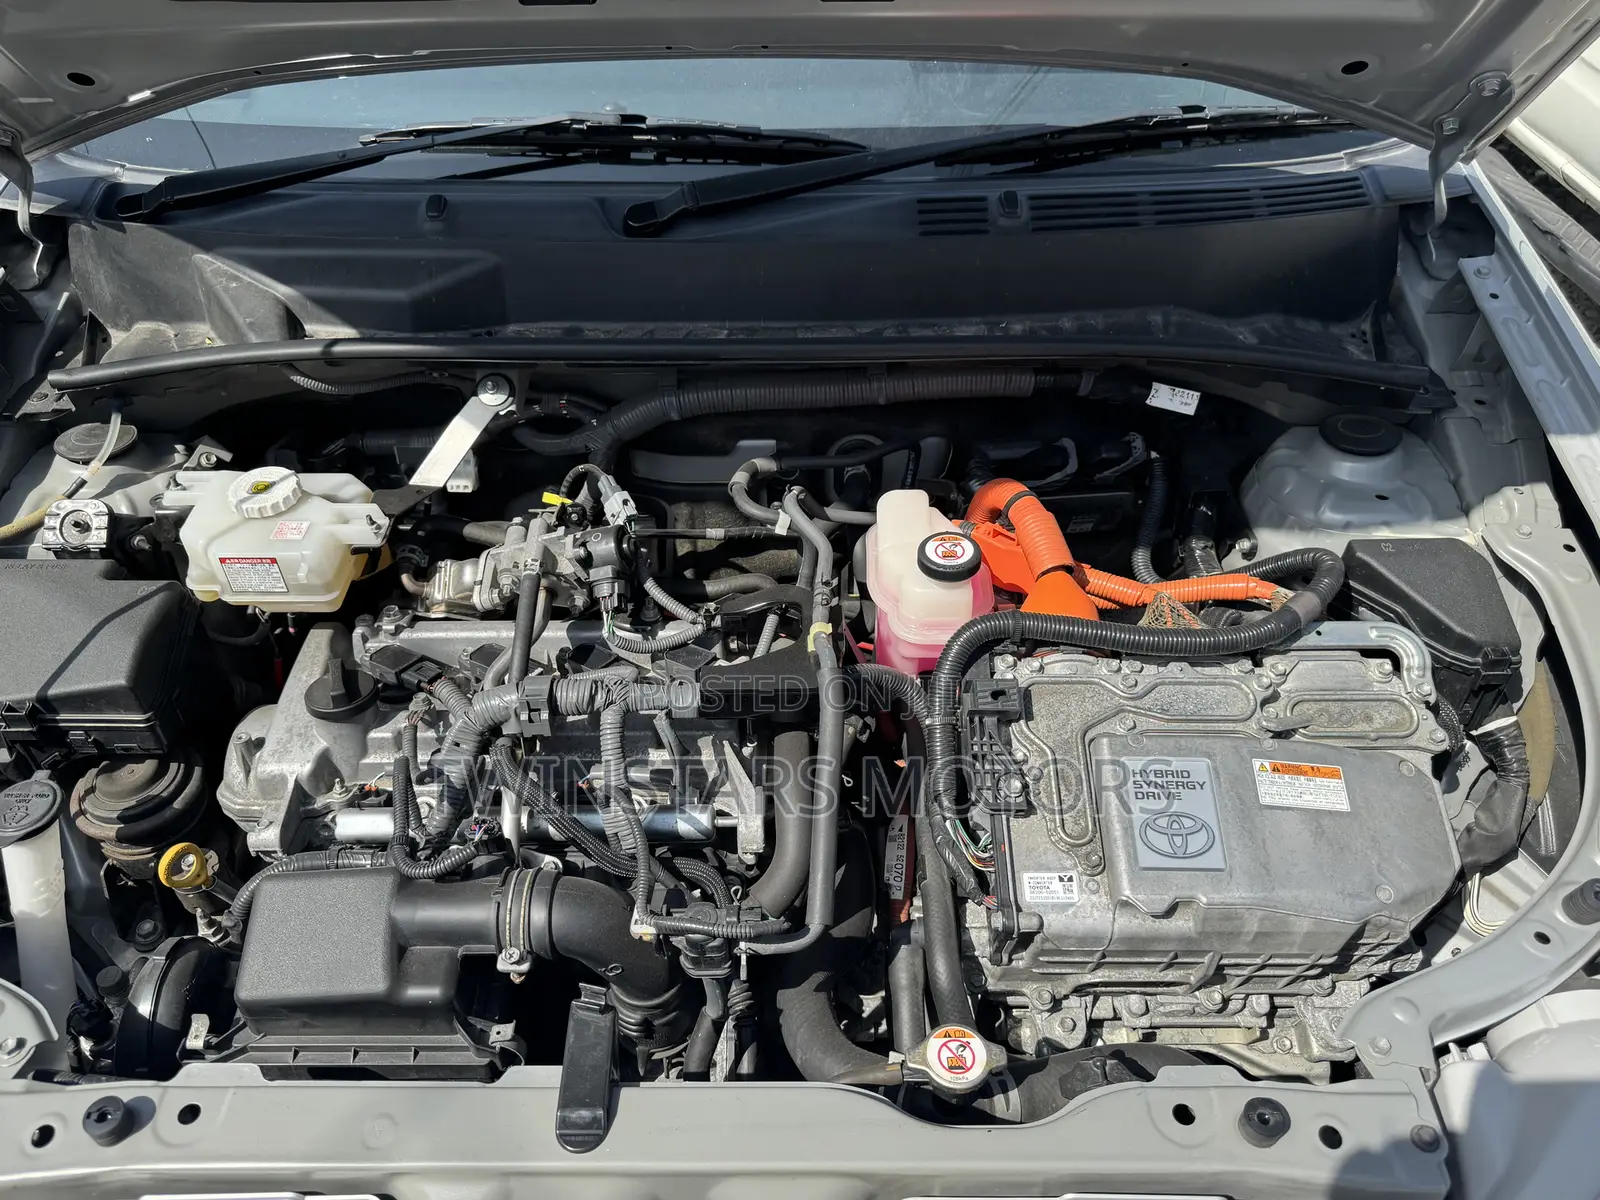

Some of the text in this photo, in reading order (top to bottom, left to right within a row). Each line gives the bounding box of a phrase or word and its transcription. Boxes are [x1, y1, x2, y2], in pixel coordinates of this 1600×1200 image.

[1381, 542, 1396, 552] C2
[1131, 769, 1191, 779] HYBRID
[1133, 780, 1206, 790] SYNERGY
[1134, 791, 1182, 800] DRIVE
